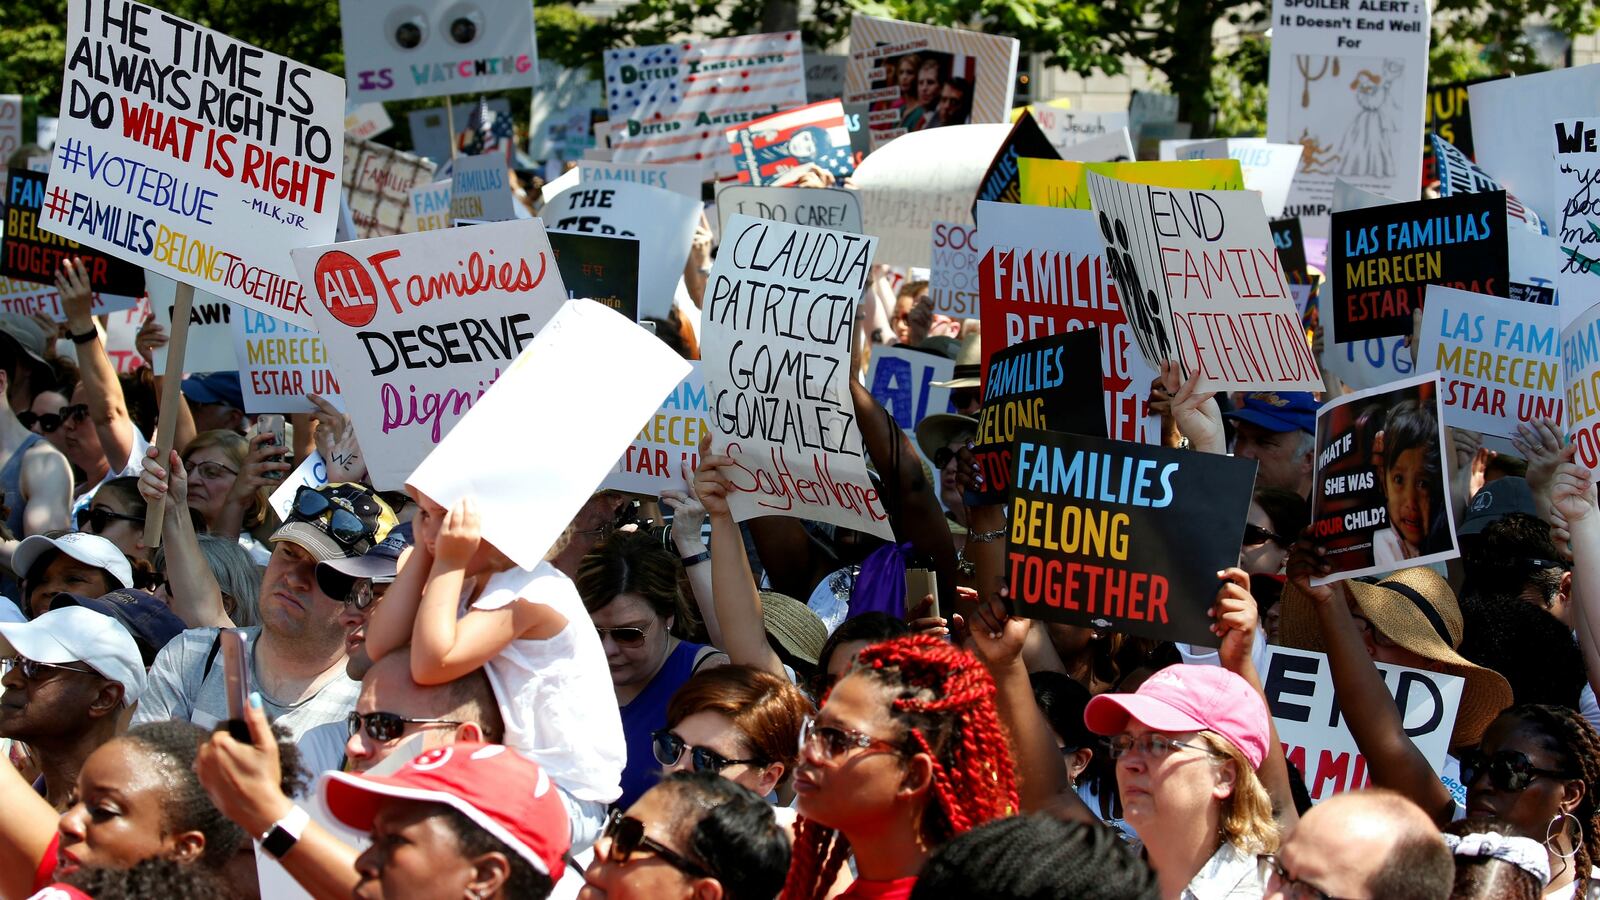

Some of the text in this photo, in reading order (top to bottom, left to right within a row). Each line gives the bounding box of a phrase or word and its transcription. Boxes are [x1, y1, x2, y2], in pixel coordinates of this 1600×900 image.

[1280, 15, 1421, 33] It Doesn't End Well
[1284, 0, 1349, 10] SPOILER
[1359, 0, 1410, 13] ALERT
[161, 14, 263, 97] TIME
[276, 60, 314, 115] IS
[1337, 36, 1362, 48] For
[68, 37, 331, 163] ALWAYS RIGHT TO
[357, 69, 393, 91] IS
[69, 79, 114, 129] DO
[120, 97, 203, 162] WHAT
[204, 129, 237, 178] IS
[241, 144, 335, 213] RIGHT
[59, 138, 218, 224] #VOTEBLUE
[569, 189, 615, 210] THE
[795, 203, 848, 226] CARE!
[1151, 190, 1224, 242] END
[1346, 211, 1491, 257] LAS FAMILIAS
[319, 267, 375, 310] ALL
[366, 249, 547, 314] Families
[733, 224, 871, 289] CLAUDIA
[1161, 247, 1287, 300] FAMILY
[1346, 251, 1442, 290] MERECEN
[709, 275, 855, 352] PATRICIA
[1347, 288, 1411, 323] ESTAR
[1440, 308, 1485, 344] LAS
[356, 313, 534, 377] DESERVE
[1174, 312, 1321, 383] DETENTION
[1435, 342, 1558, 392] MERECEN
[250, 370, 305, 396] ESTAR
[728, 340, 842, 407] GOMEZ
[984, 345, 1065, 402] FAMILIES
[716, 389, 861, 457] GONZALEZ
[974, 397, 1047, 447] BELONG
[331, 451, 358, 472] WE
[1016, 442, 1180, 508] FAMILIES
[1318, 432, 1353, 471] WHAT IF
[1324, 471, 1374, 496] SHE WAS
[1011, 497, 1130, 561] BELONG
[1344, 506, 1387, 531] CHILD?
[1008, 552, 1169, 624] TOGETHER
